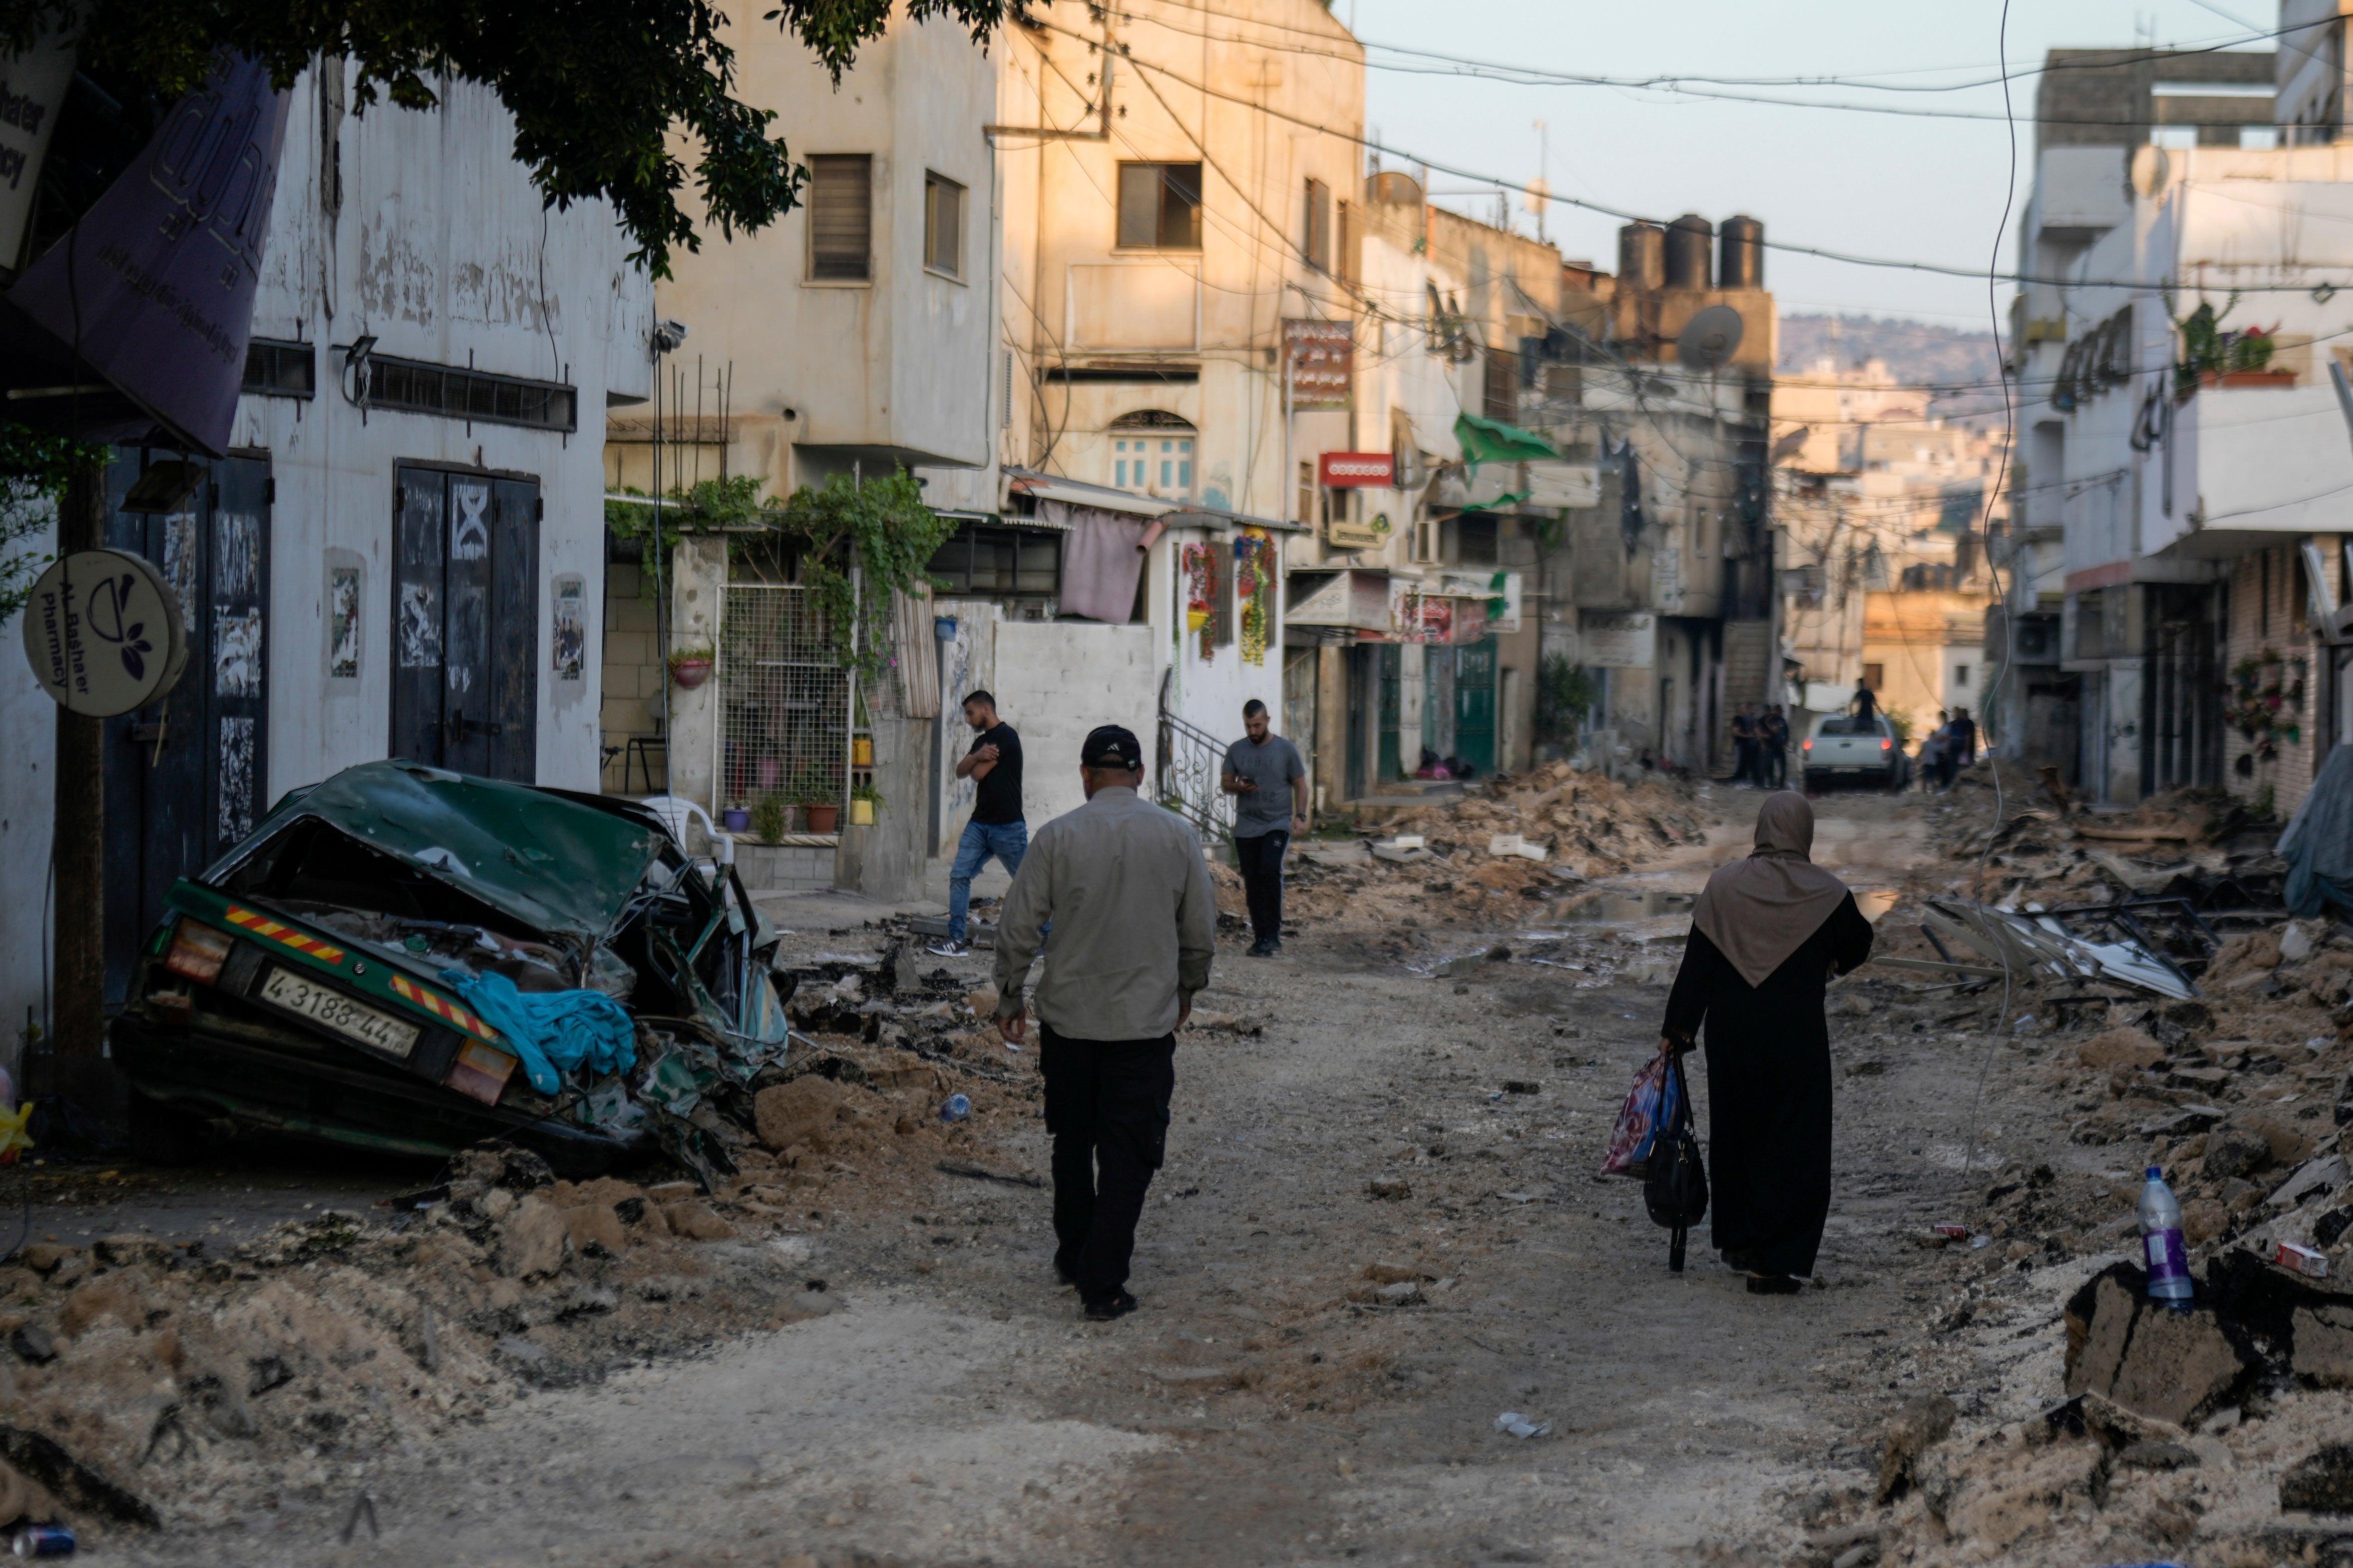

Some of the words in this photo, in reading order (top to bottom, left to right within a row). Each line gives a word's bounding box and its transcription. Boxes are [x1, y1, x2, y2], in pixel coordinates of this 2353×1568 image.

[1329, 464, 1389, 476] ooredoo
[1335, 530, 1379, 544] Jawwal
[40, 593, 68, 688] Pharmacy
[67, 613, 89, 695] Basha'er
